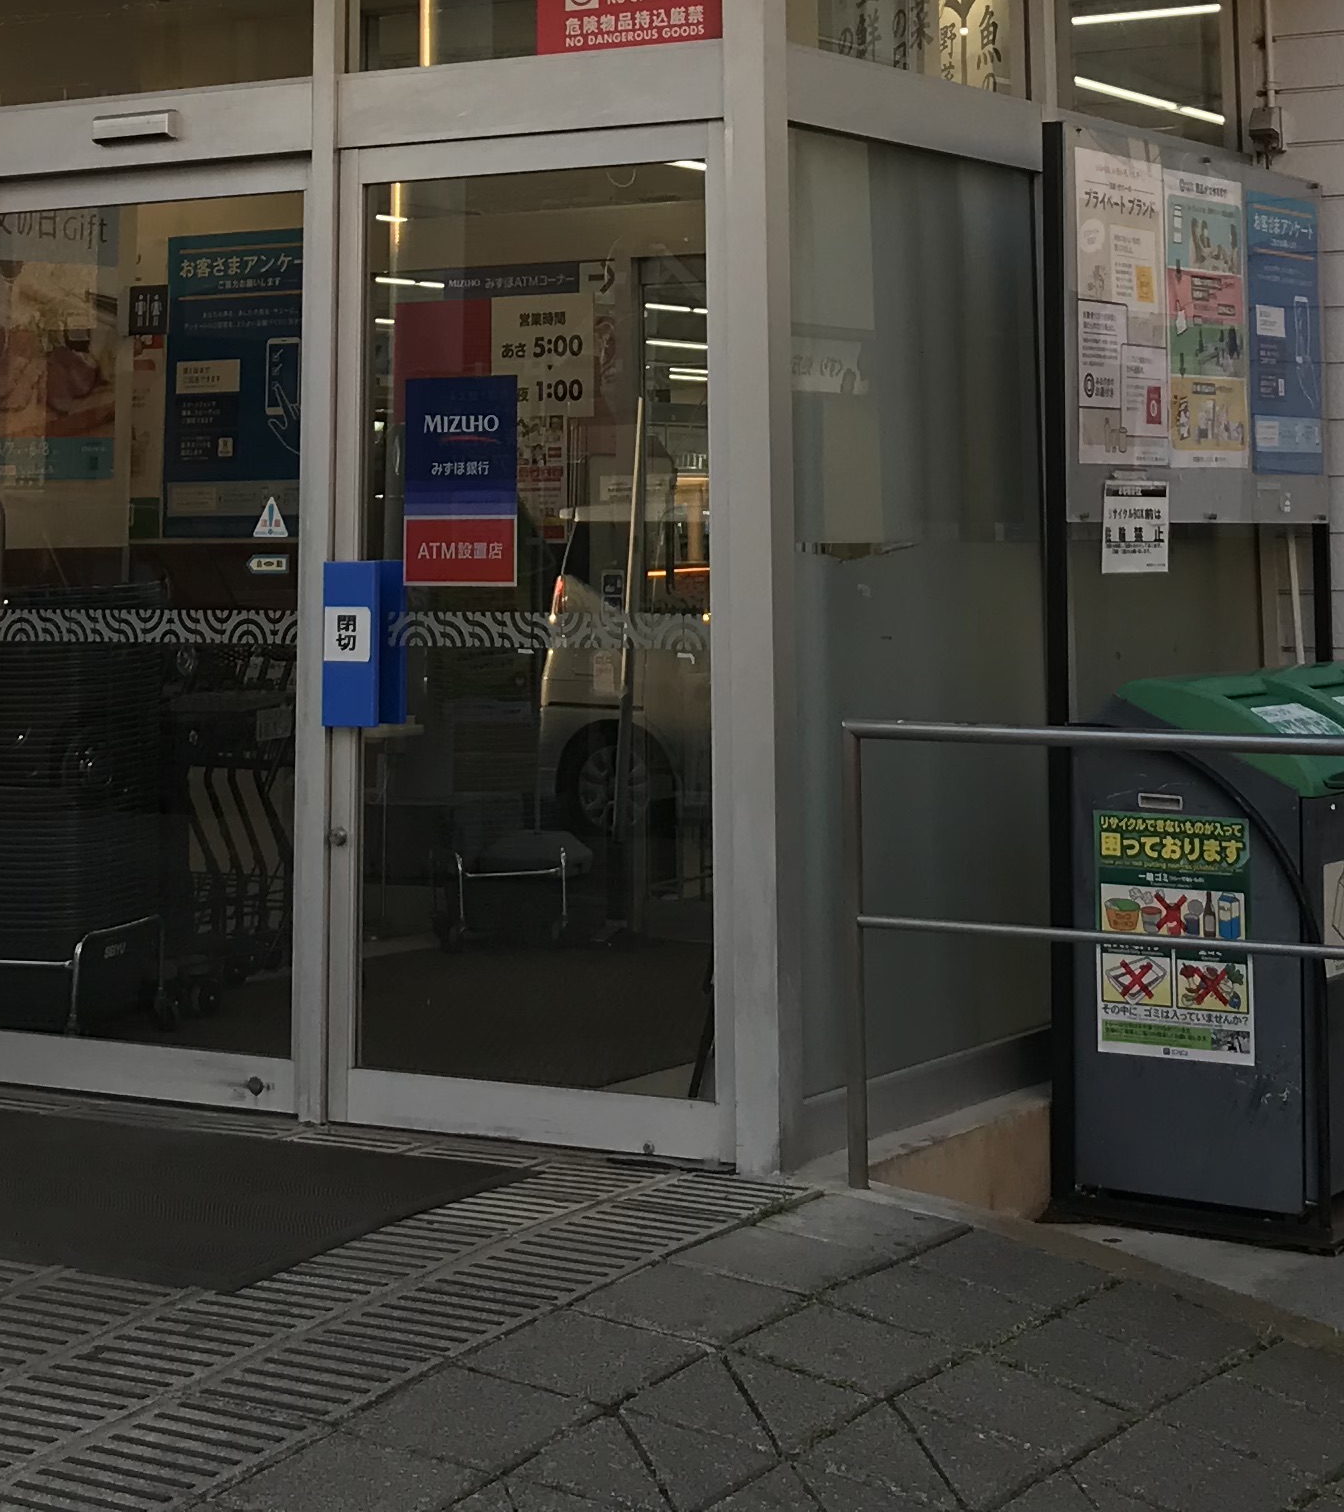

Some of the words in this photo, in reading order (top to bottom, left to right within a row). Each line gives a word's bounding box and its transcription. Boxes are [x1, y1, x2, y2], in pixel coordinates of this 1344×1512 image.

[565, 5, 704, 36] 危険物品持込厳禁
[565, 37, 584, 47] NO
[587, 28, 658, 45] DANGEROUS
[662, 24, 705, 37] GOODS
[63, 214, 108, 249] Gift
[448, 278, 481, 289] MIZUHO
[484, 273, 575, 290] みずほATMコーナー
[519, 311, 566, 327] 営業時間
[501, 343, 526, 358] あさ
[532, 334, 584, 358] 5:00
[536, 378, 583, 402] 1:00
[423, 414, 500, 434] MIZUHO
[430, 461, 490, 476] みずほ銀行
[417, 542, 503, 560] ATM設置店
[1100, 816, 1243, 838] リサイクルできないものが入って
[1100, 832, 1245, 864] 困っております
[1102, 1004, 1249, 1026] その中に、ゴミは入っていませんか?
